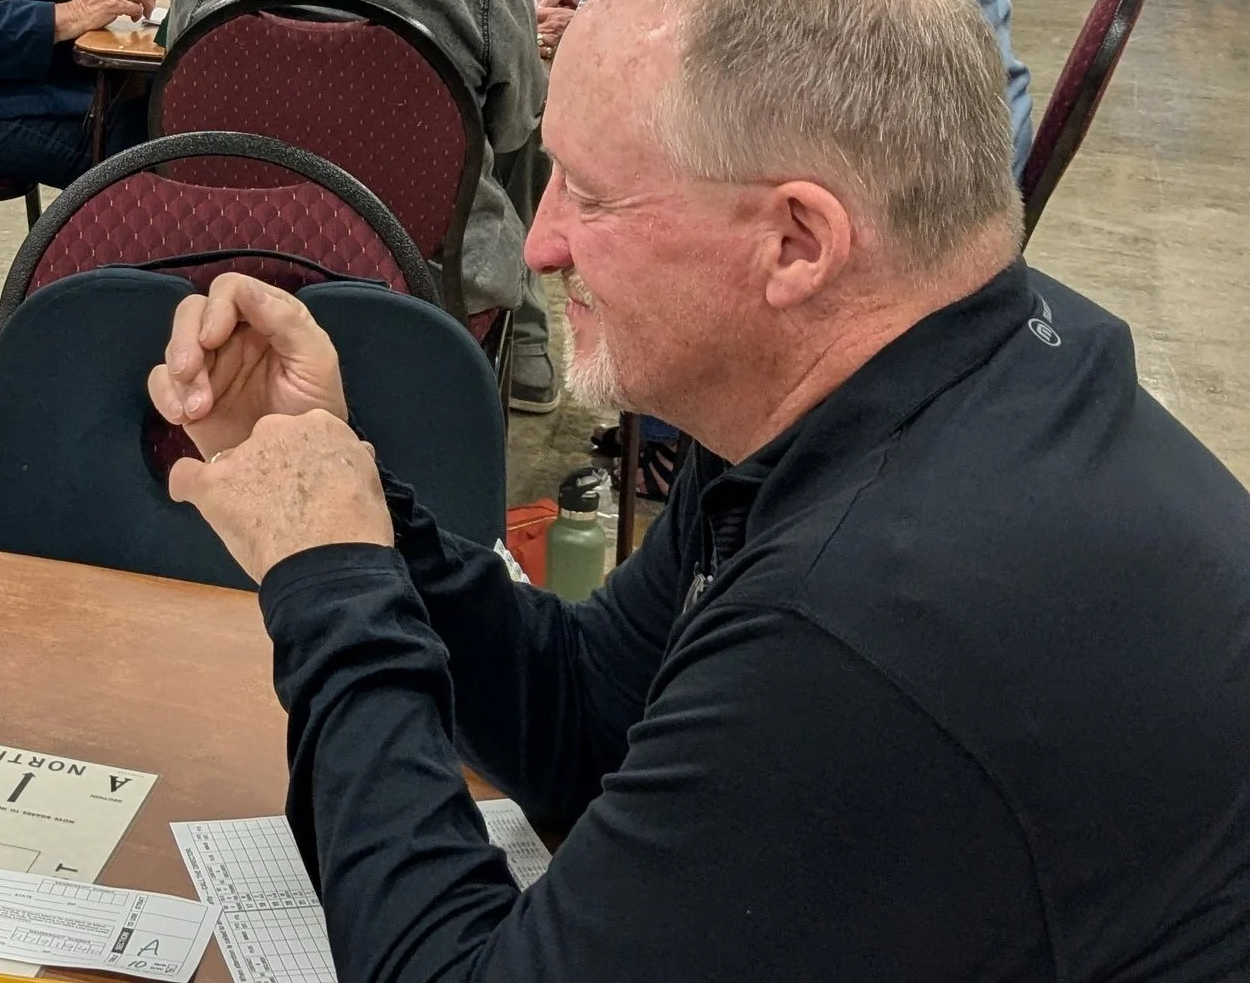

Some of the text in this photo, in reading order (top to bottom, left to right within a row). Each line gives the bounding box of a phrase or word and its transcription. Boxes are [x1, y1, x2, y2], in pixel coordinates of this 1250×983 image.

[108, 774, 133, 793] A
[194, 869, 203, 878] THE
[198, 878, 209, 890] CALL
[137, 938, 160, 956] A
